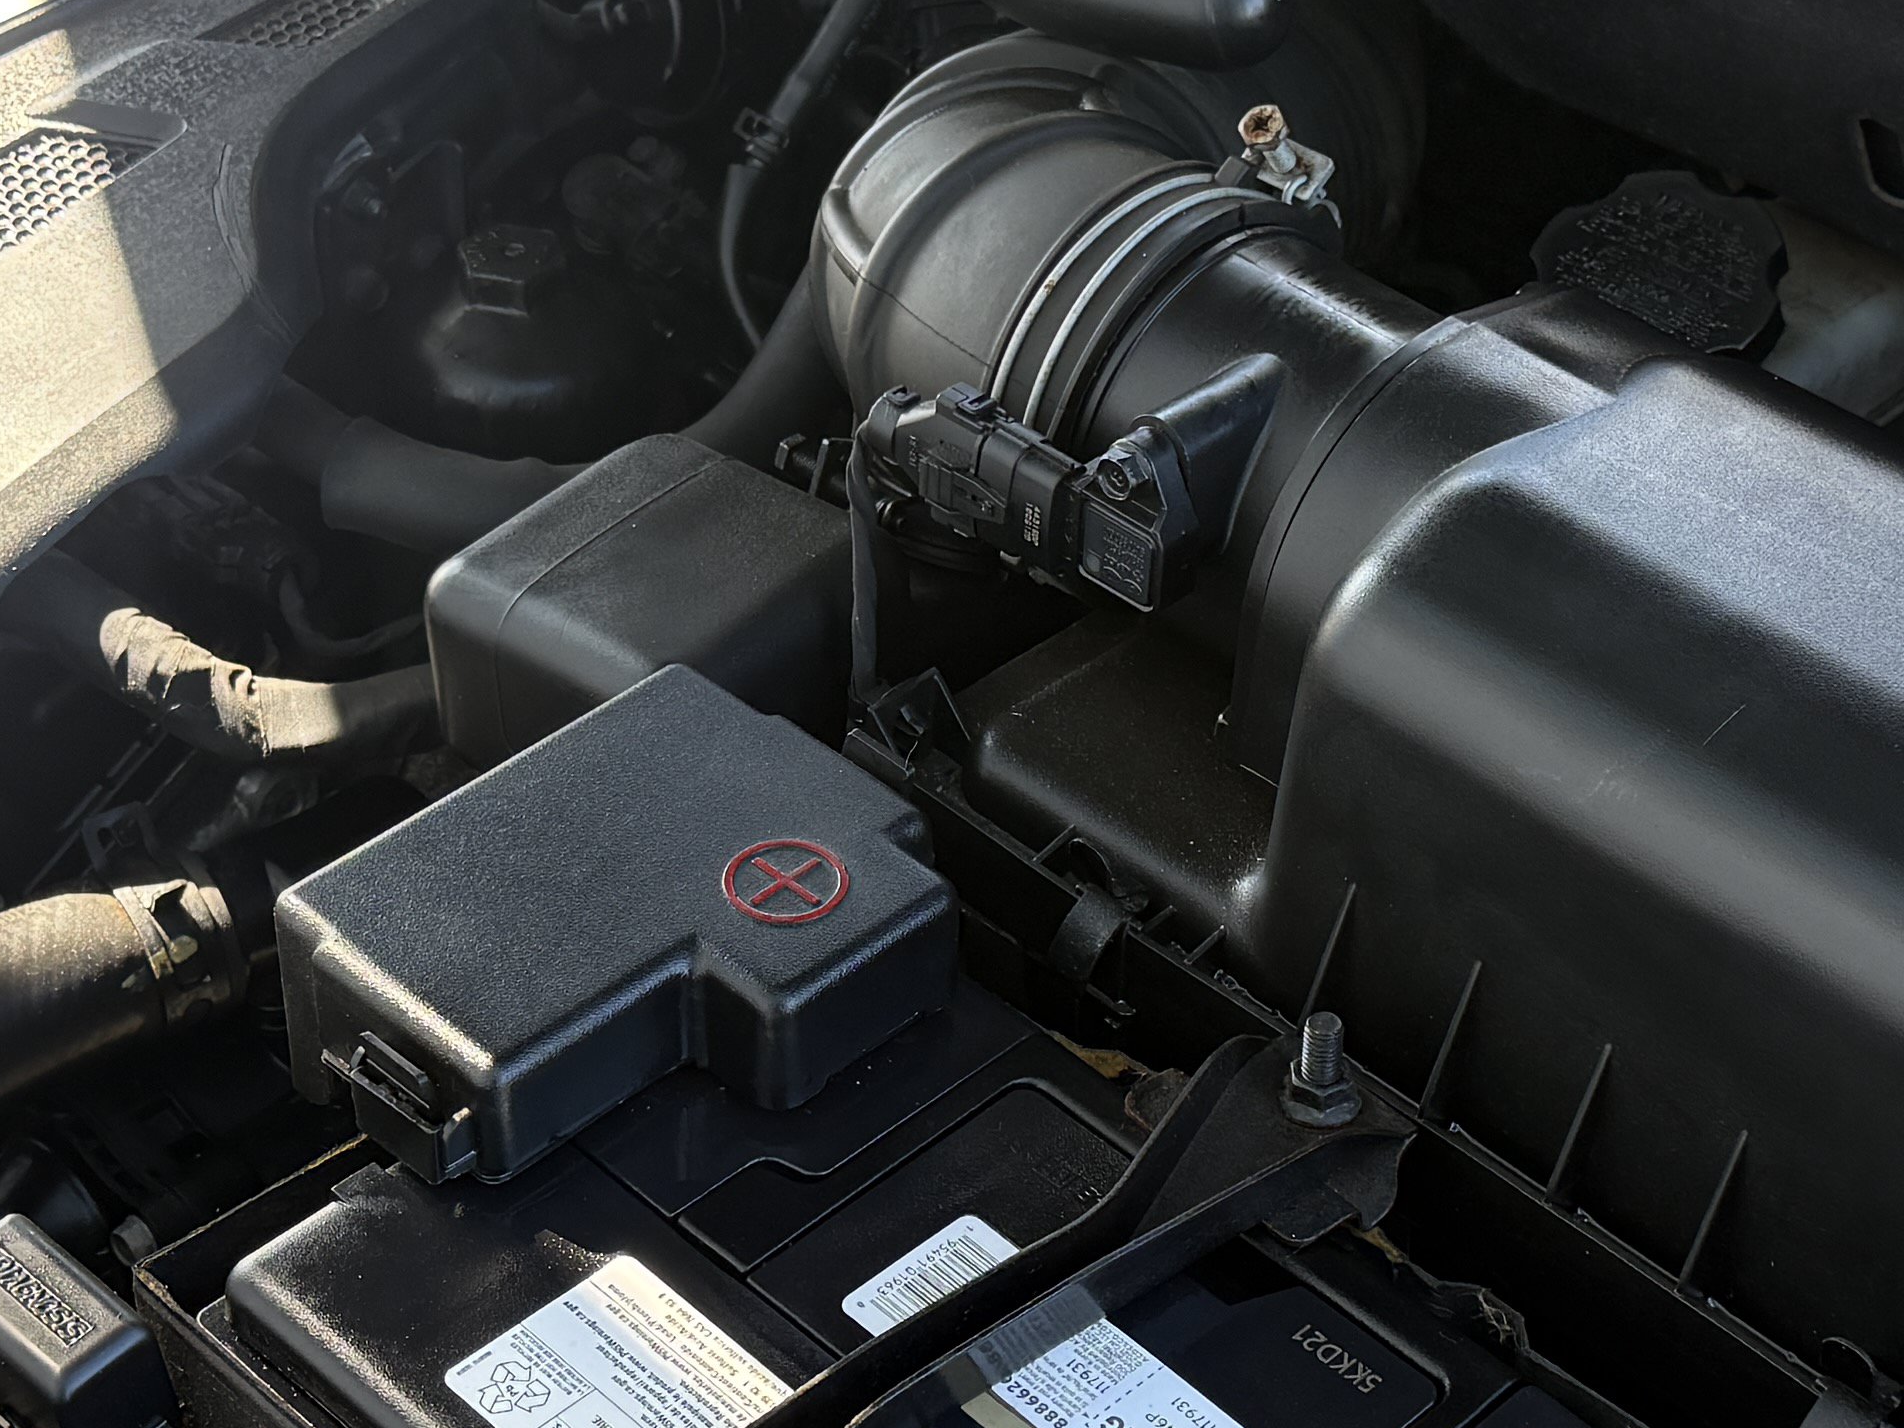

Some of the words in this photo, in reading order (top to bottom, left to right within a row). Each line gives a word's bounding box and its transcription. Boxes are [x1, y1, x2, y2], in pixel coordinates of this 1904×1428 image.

[915, 1237, 958, 1268] 95491
[1065, 1357, 1111, 1394] 117931
[1291, 1321, 1383, 1395] 5KKD21
